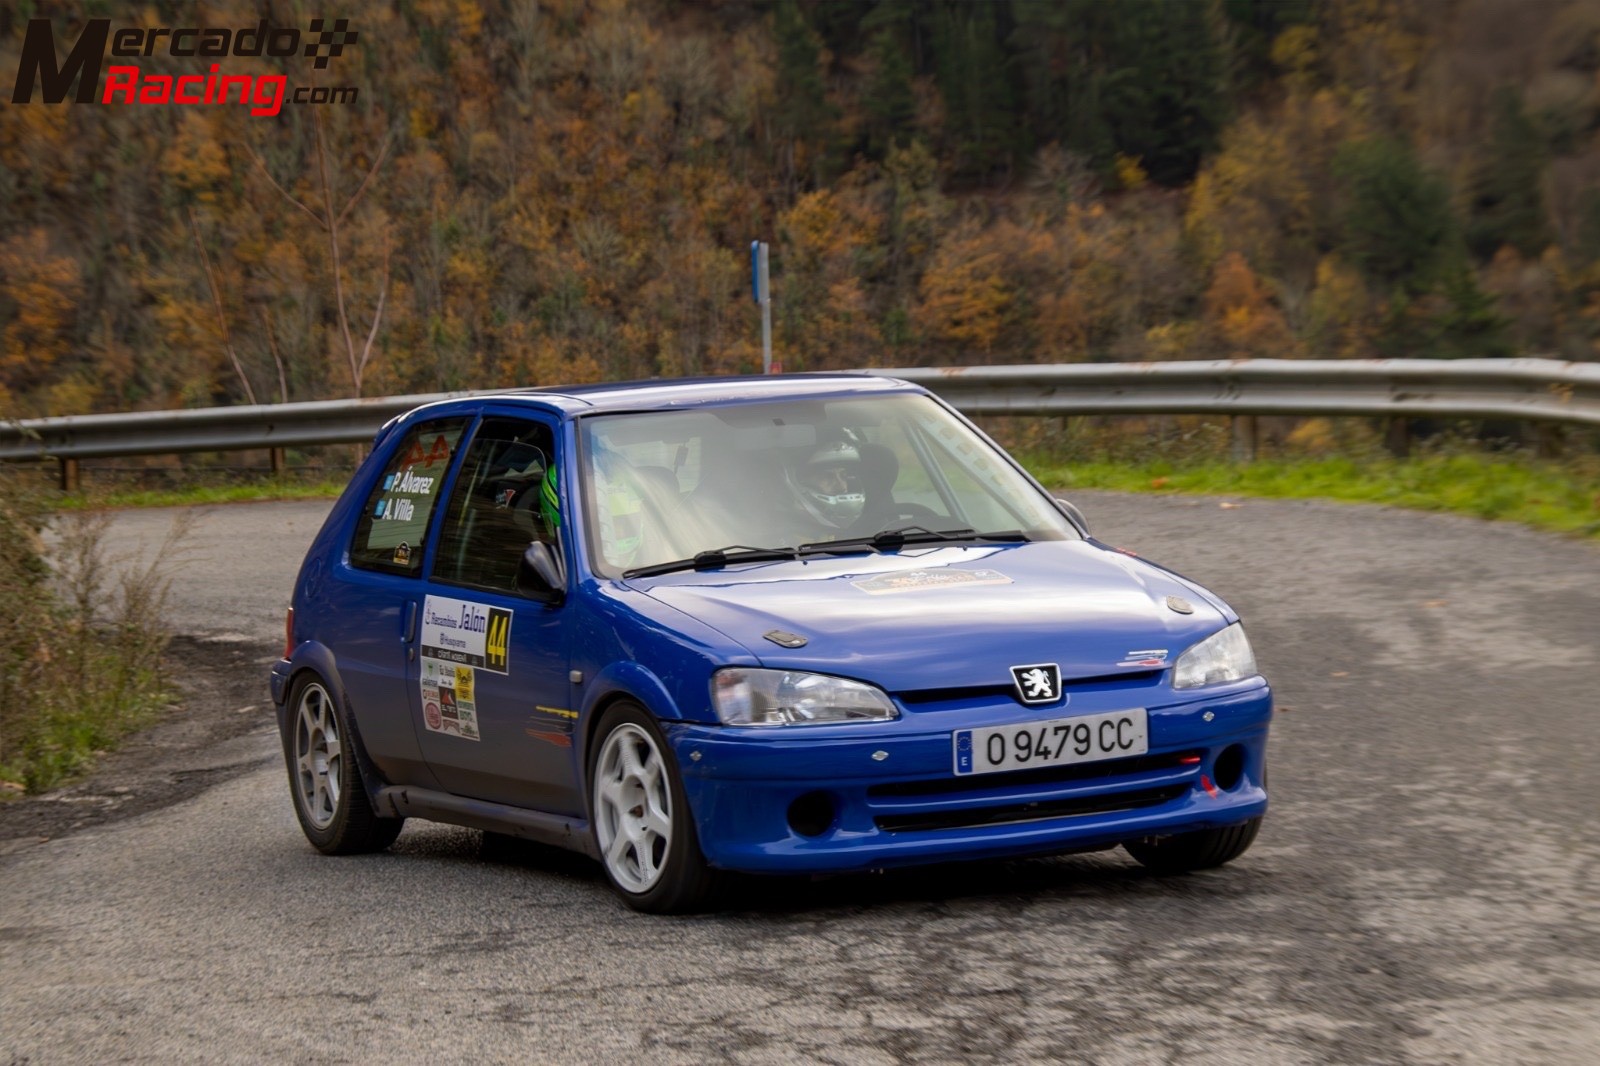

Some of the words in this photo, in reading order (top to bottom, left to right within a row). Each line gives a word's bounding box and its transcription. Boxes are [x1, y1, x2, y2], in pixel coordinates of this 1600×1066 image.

[393, 498, 415, 521] Villa
[458, 604, 486, 634] Jalón
[487, 614, 508, 667] 44
[1014, 723, 1091, 763] 9479
[1099, 717, 1134, 753] CC
[961, 756, 969, 767] E
